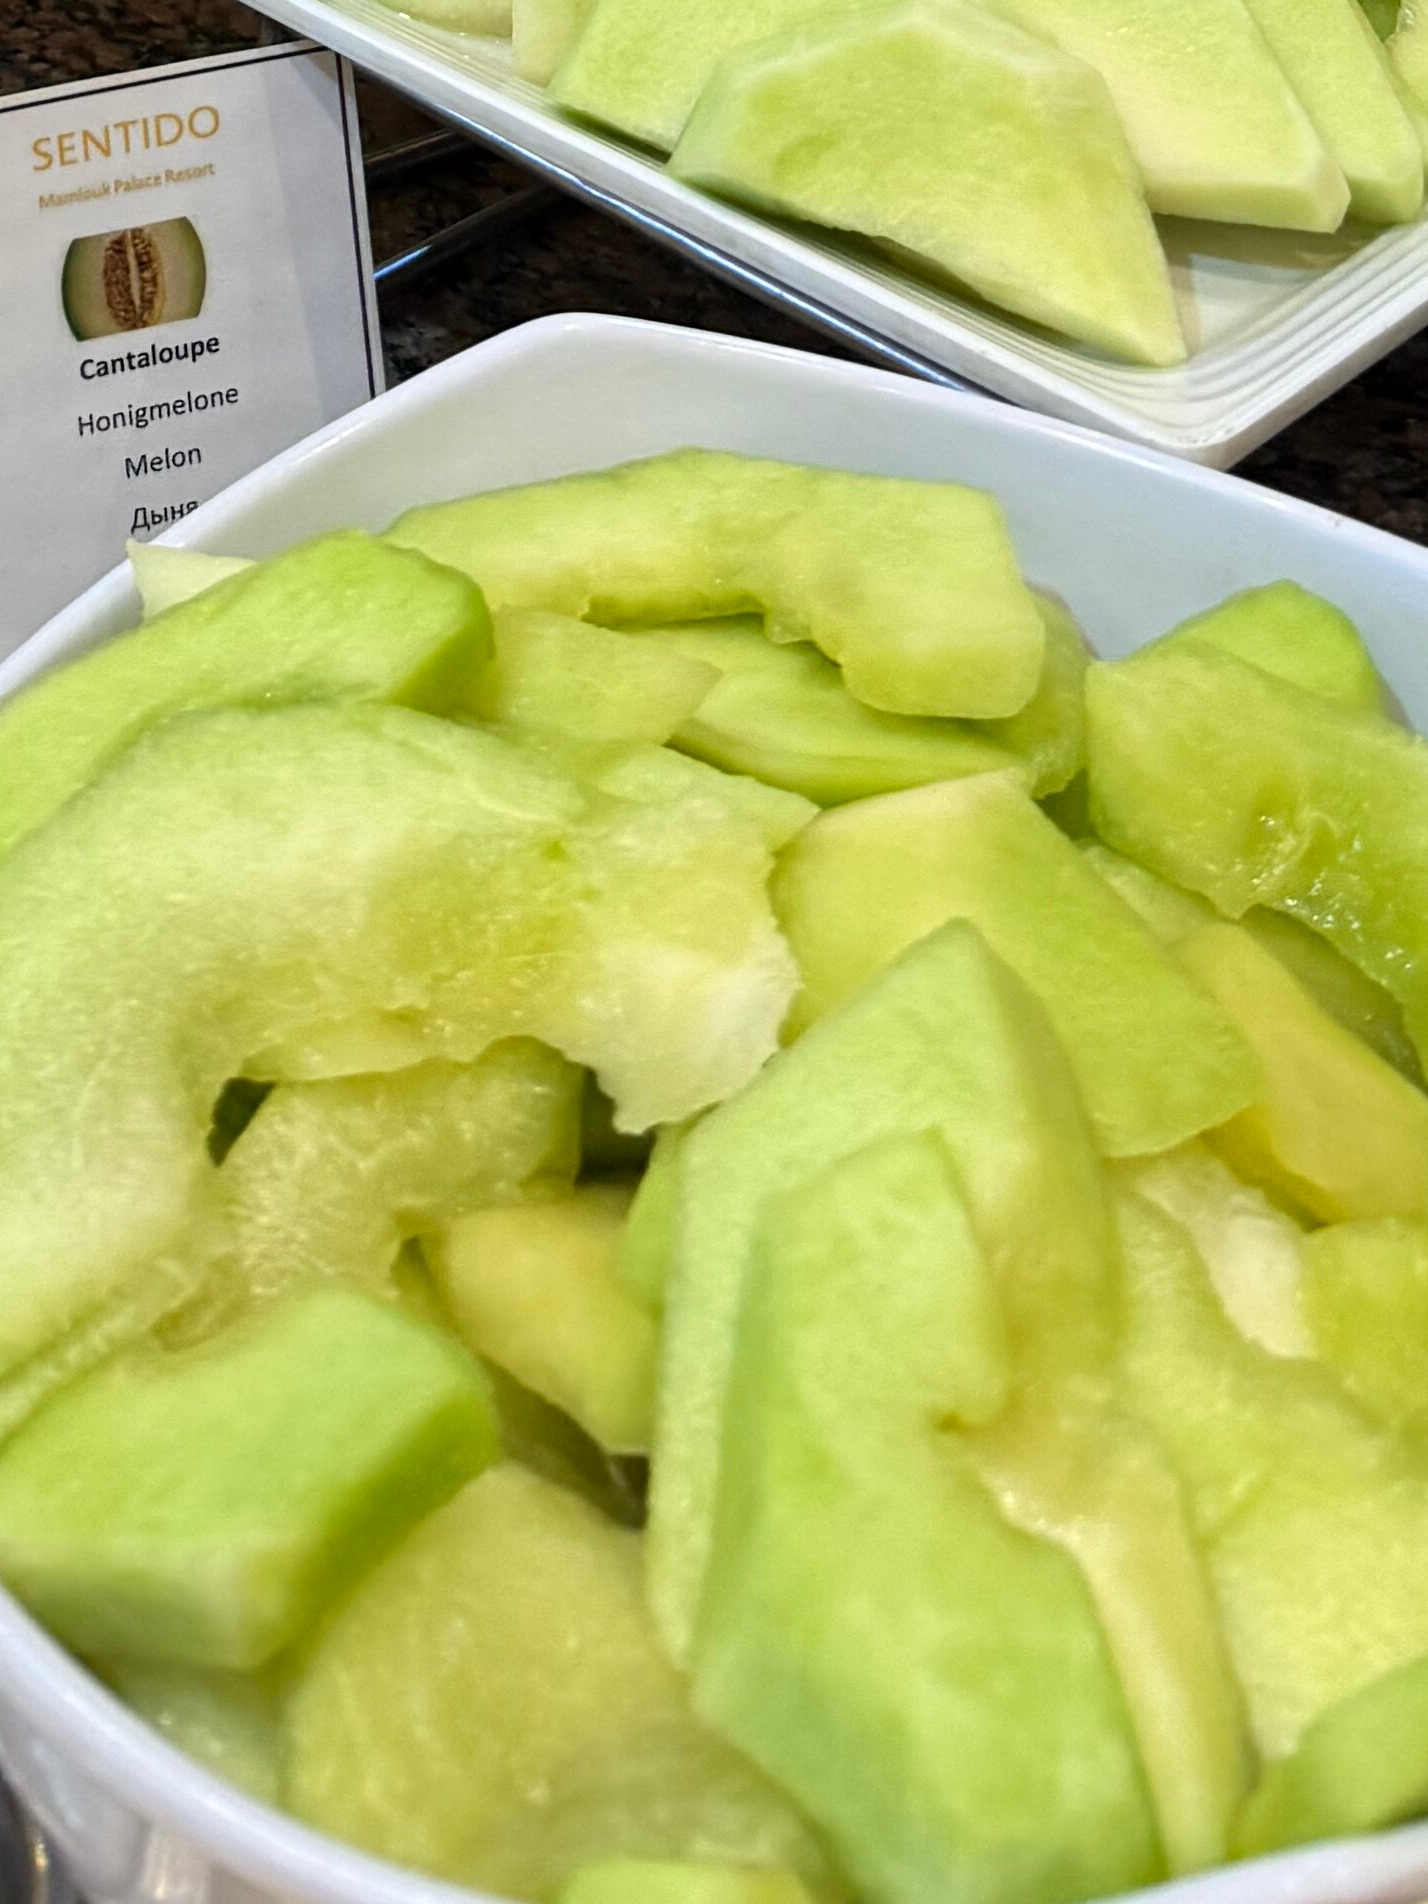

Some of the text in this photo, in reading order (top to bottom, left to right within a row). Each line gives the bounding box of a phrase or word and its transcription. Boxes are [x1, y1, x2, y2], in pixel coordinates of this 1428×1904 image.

[31, 105, 221, 172] SENTIDO
[38, 163, 216, 210] Mamlouk Palace Resort
[79, 336, 221, 380] Cantaloupe
[78, 387, 240, 437] Honigmelone
[124, 447, 202, 479] Melon
